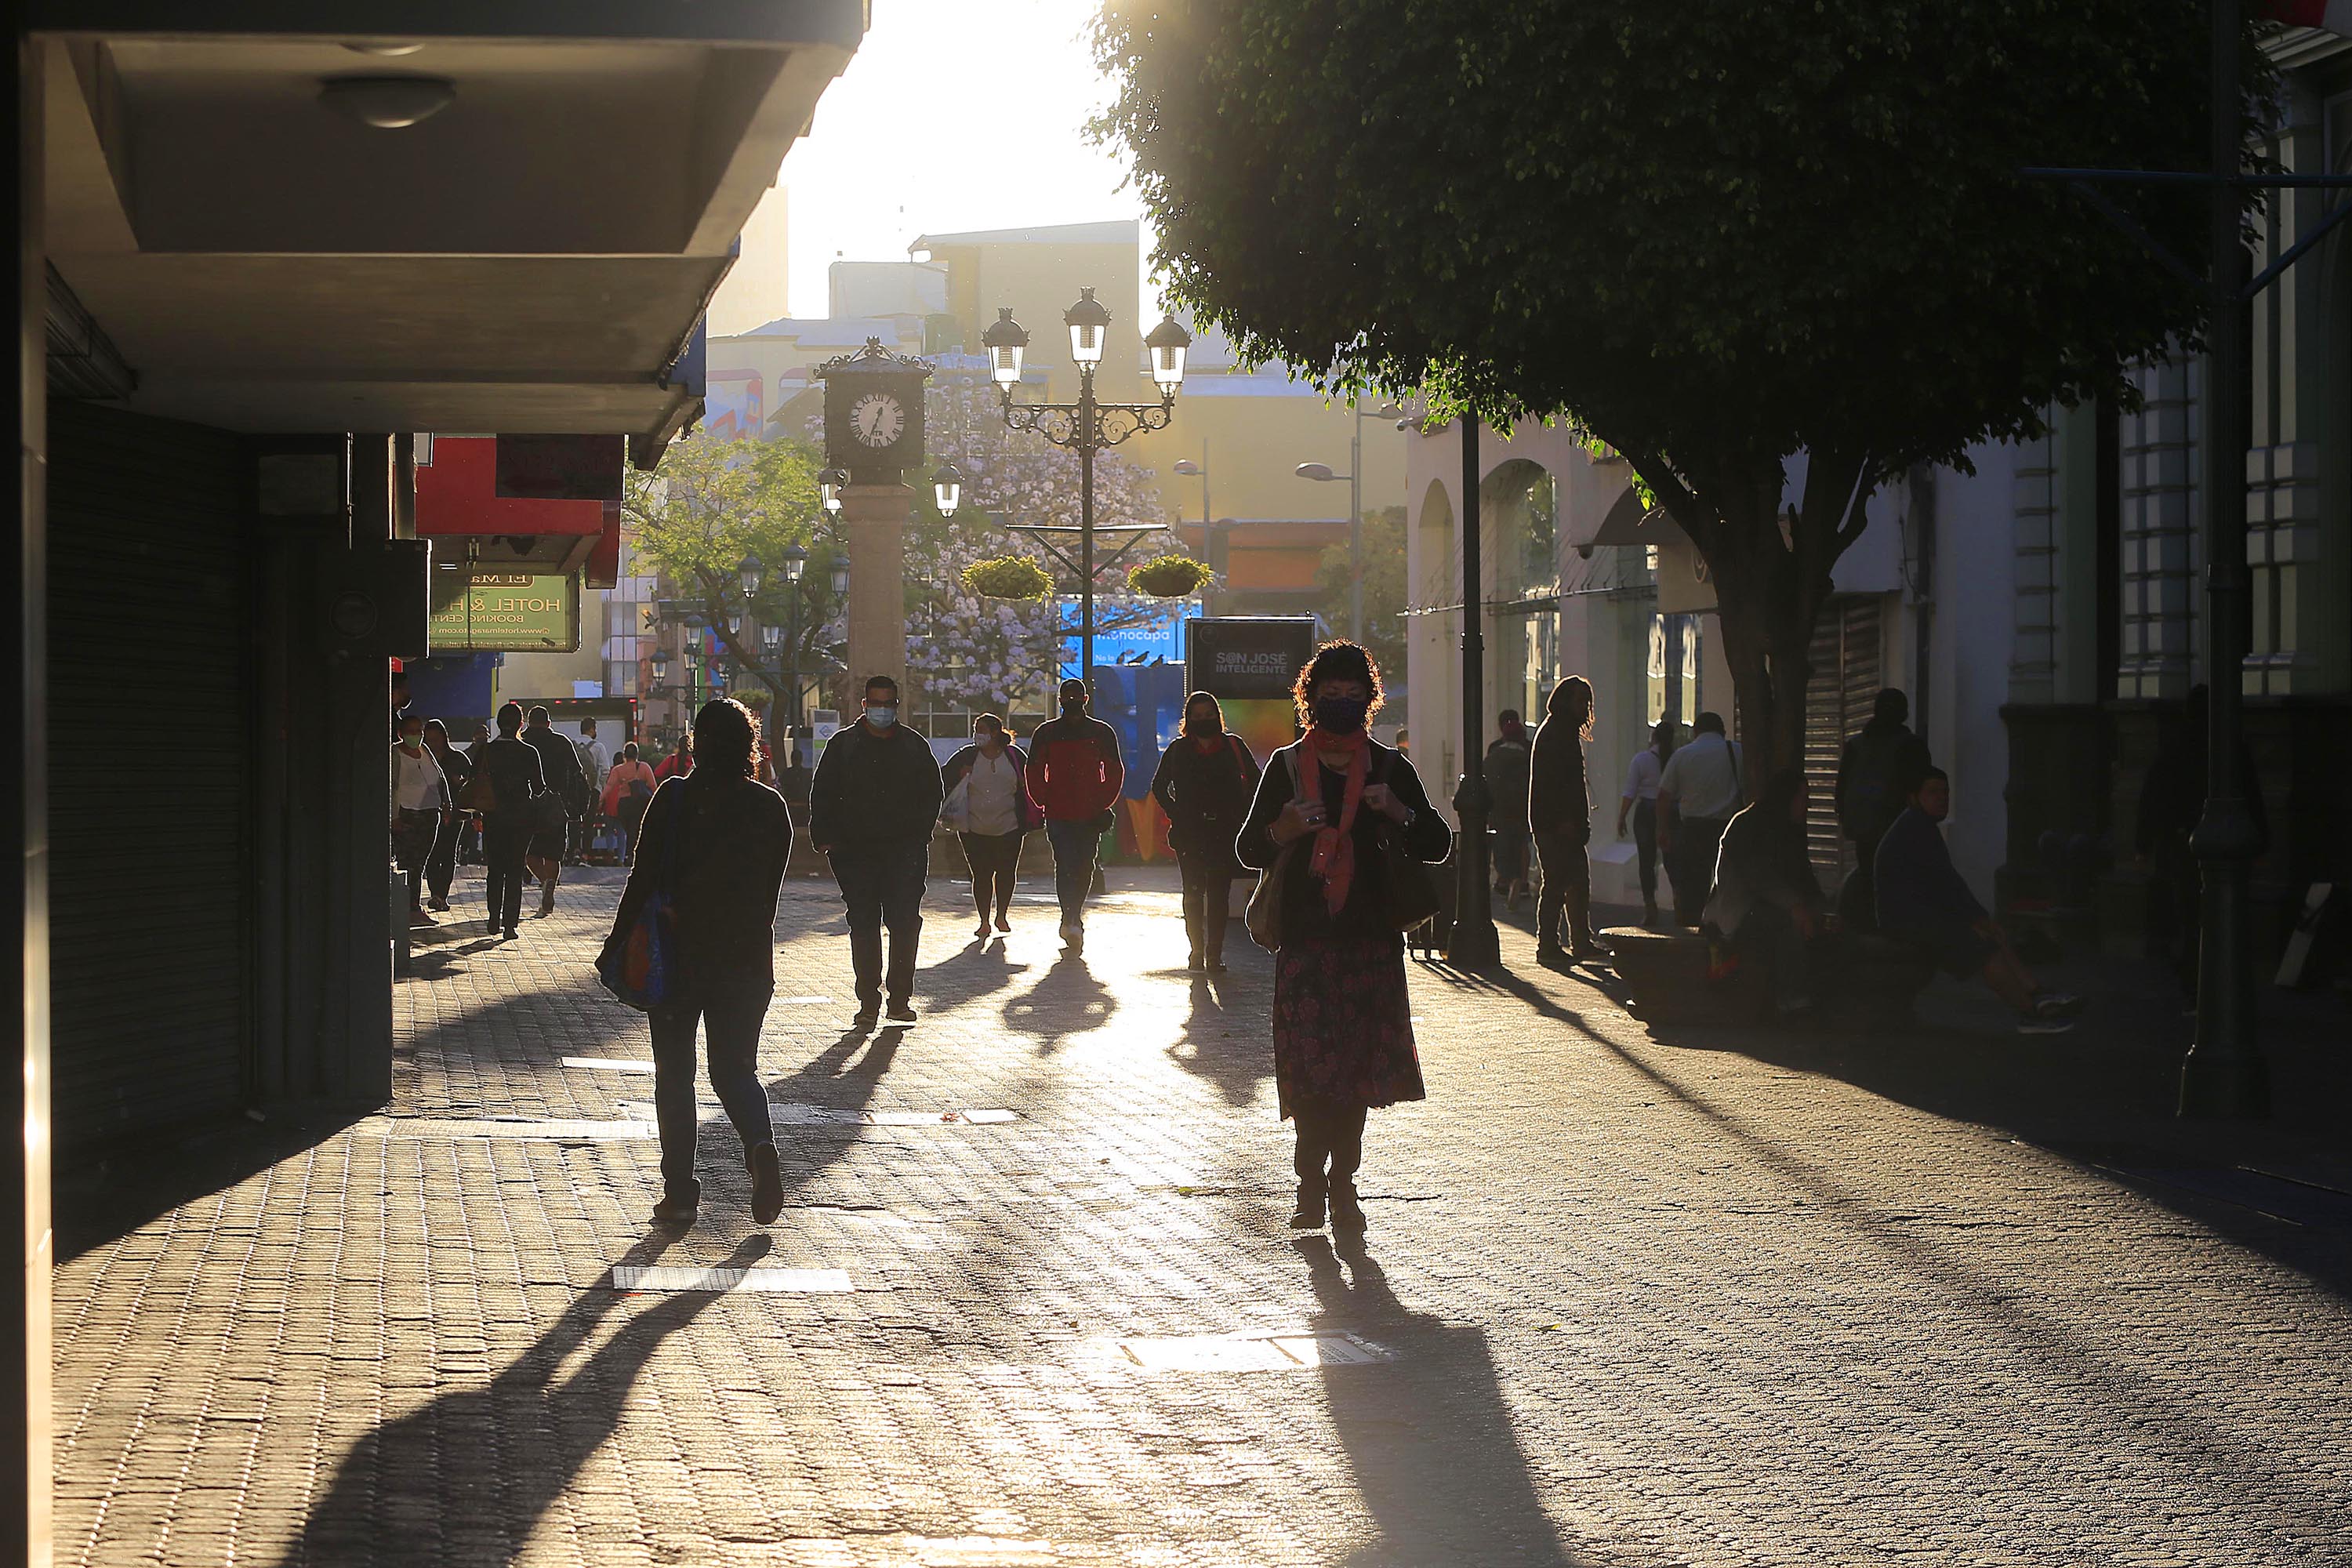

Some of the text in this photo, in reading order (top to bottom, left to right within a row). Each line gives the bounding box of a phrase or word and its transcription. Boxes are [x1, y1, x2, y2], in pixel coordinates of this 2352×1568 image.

[1216, 652, 1287, 665] S@N JOSÉ
[1216, 666, 1287, 674] INTELIGENTE
